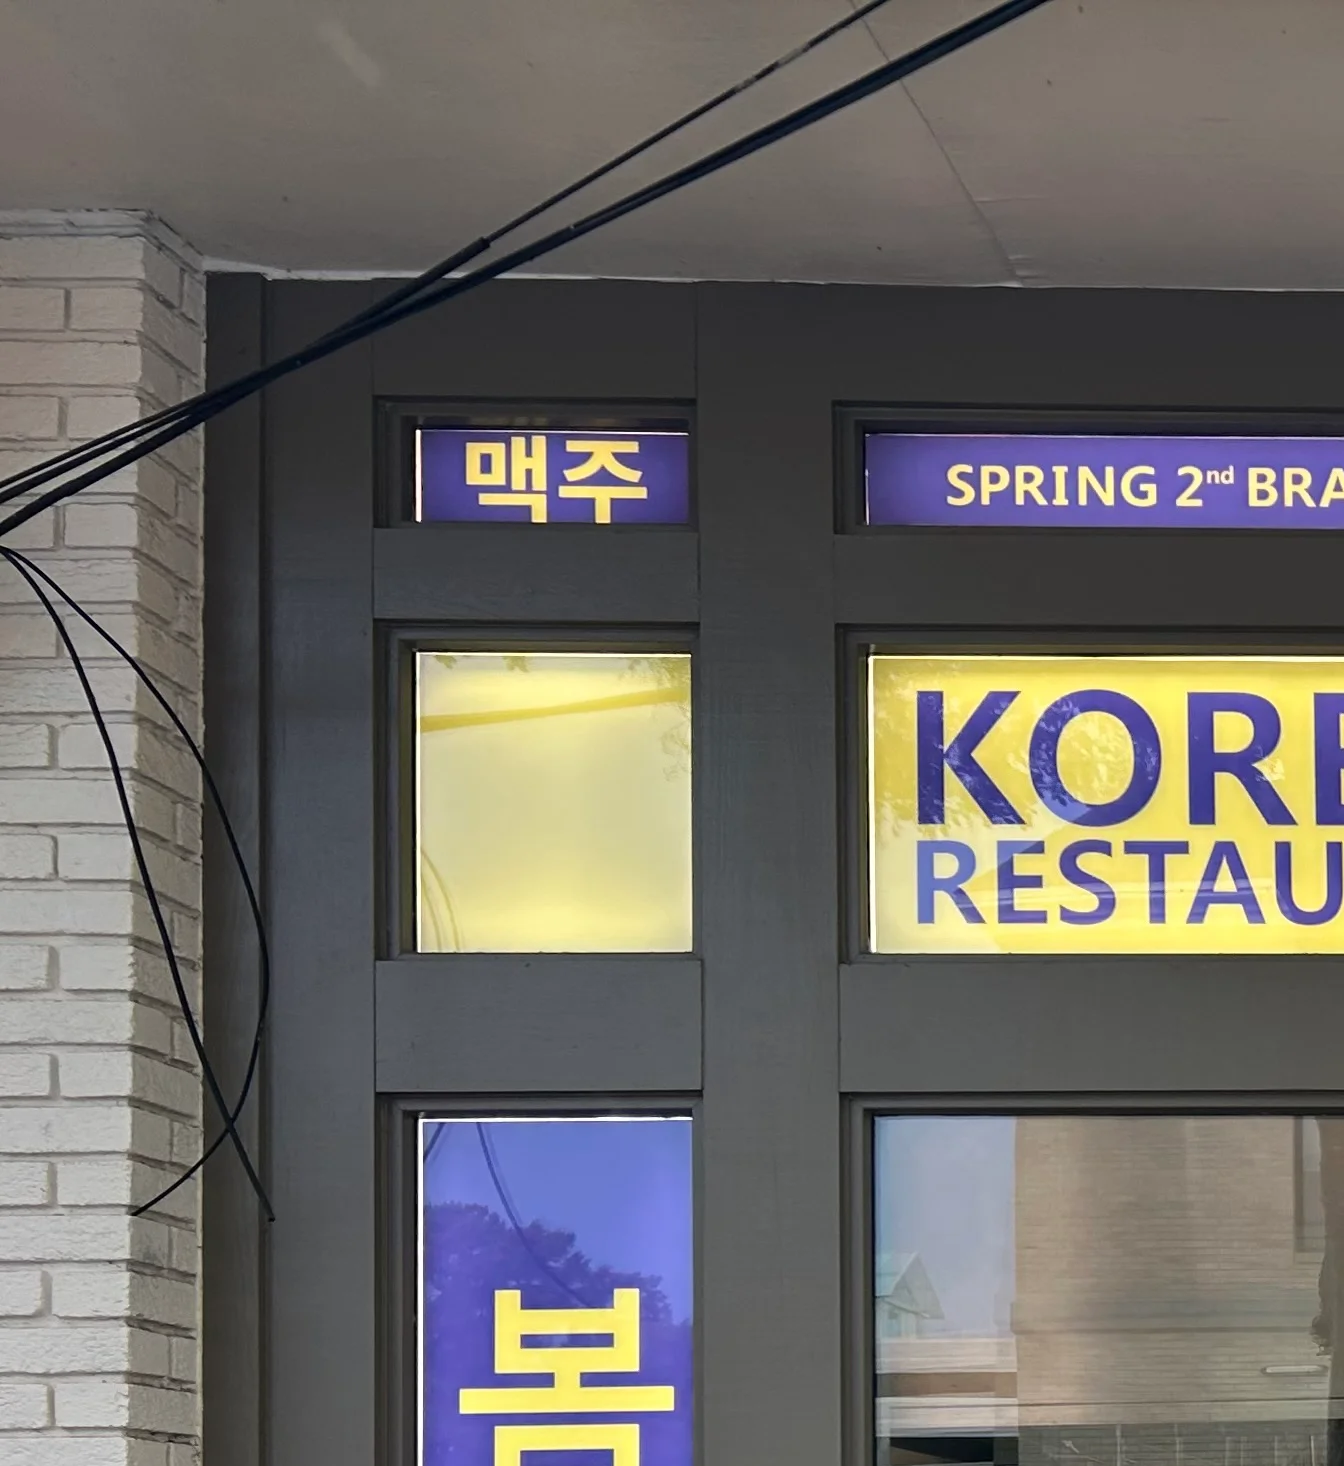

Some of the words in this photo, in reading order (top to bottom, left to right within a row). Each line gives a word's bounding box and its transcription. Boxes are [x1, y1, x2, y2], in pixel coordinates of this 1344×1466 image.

[465, 436, 648, 525] 맥주
[946, 464, 1158, 508] SPRING
[1175, 465, 1234, 508] 2nd
